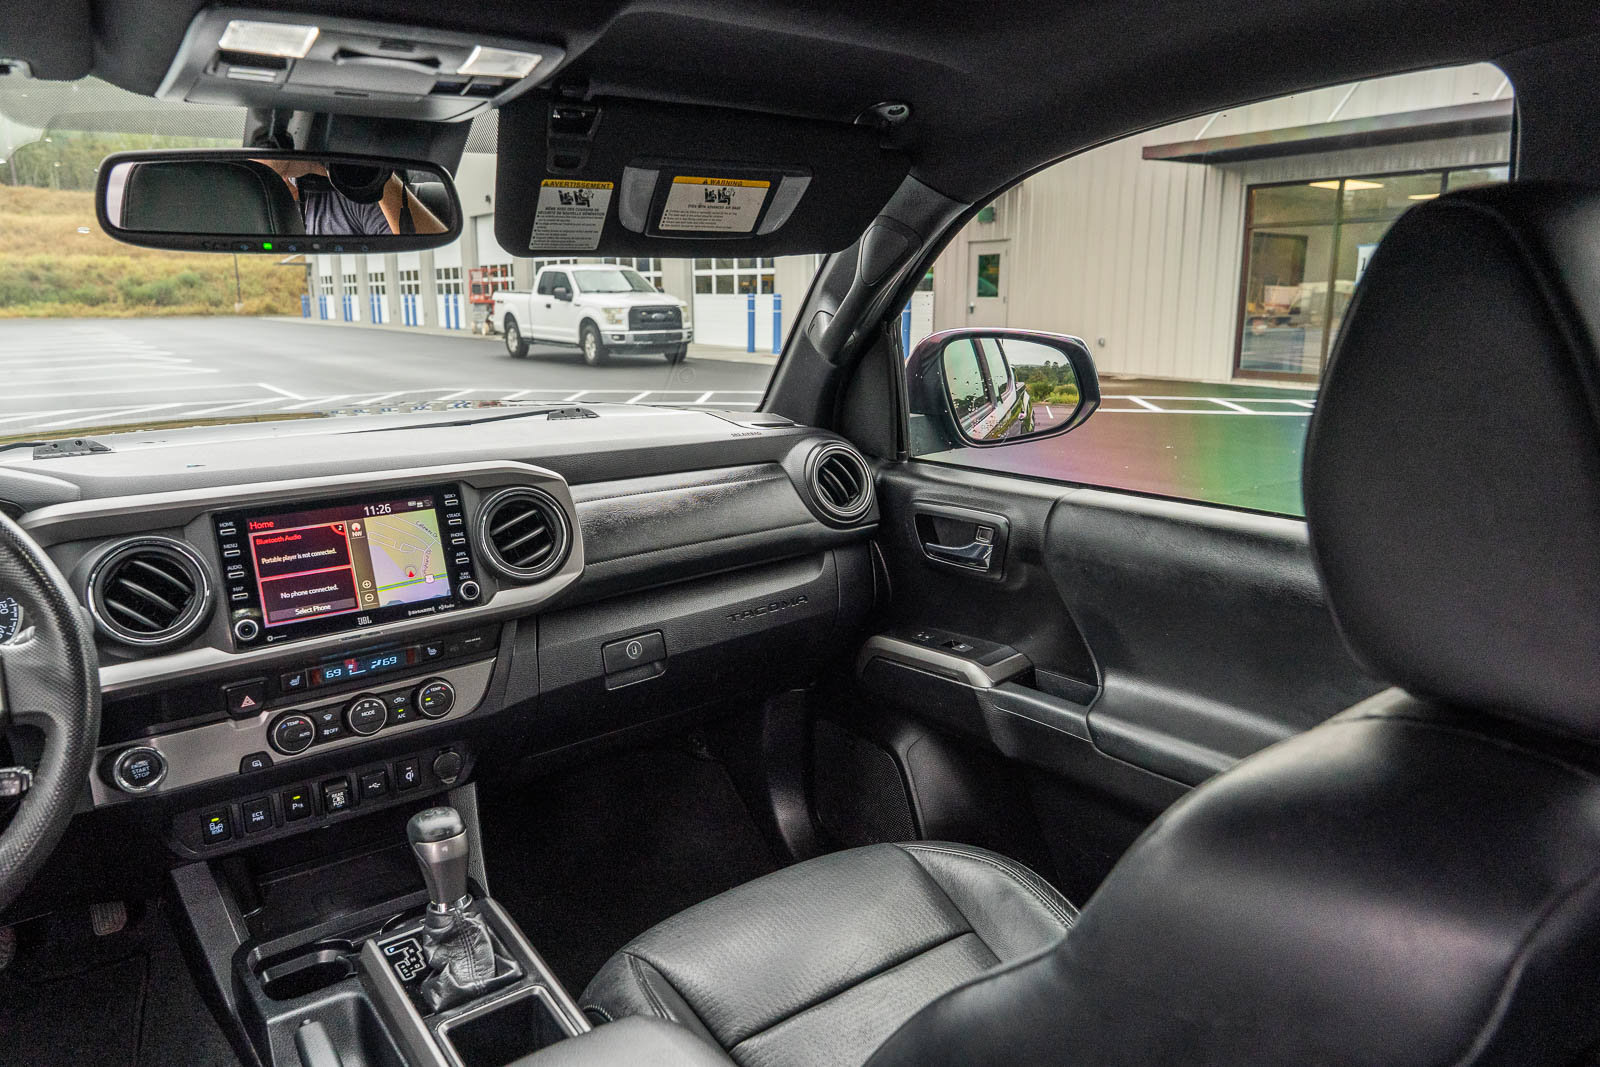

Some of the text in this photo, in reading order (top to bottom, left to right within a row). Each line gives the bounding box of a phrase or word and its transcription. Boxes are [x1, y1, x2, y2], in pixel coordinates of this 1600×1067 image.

[550, 181, 611, 189] AVERTISSEMENT
[710, 179, 743, 187] WARNING
[363, 503, 392, 515] 11:26
[249, 521, 275, 530] Home
[256, 535, 284, 545] Bluetooth
[261, 556, 282, 564] Portable
[283, 554, 297, 562] player
[310, 548, 337, 557] connected.
[291, 589, 308, 598] phone
[308, 584, 339, 593] connected.
[295, 607, 312, 615] Select
[726, 595, 809, 622] TACOMA
[357, 615, 372, 625] JBL
[382, 656, 397, 666] 69
[326, 668, 342, 678] 69
[131, 765, 150, 775] START
[134, 771, 151, 780] STOP
